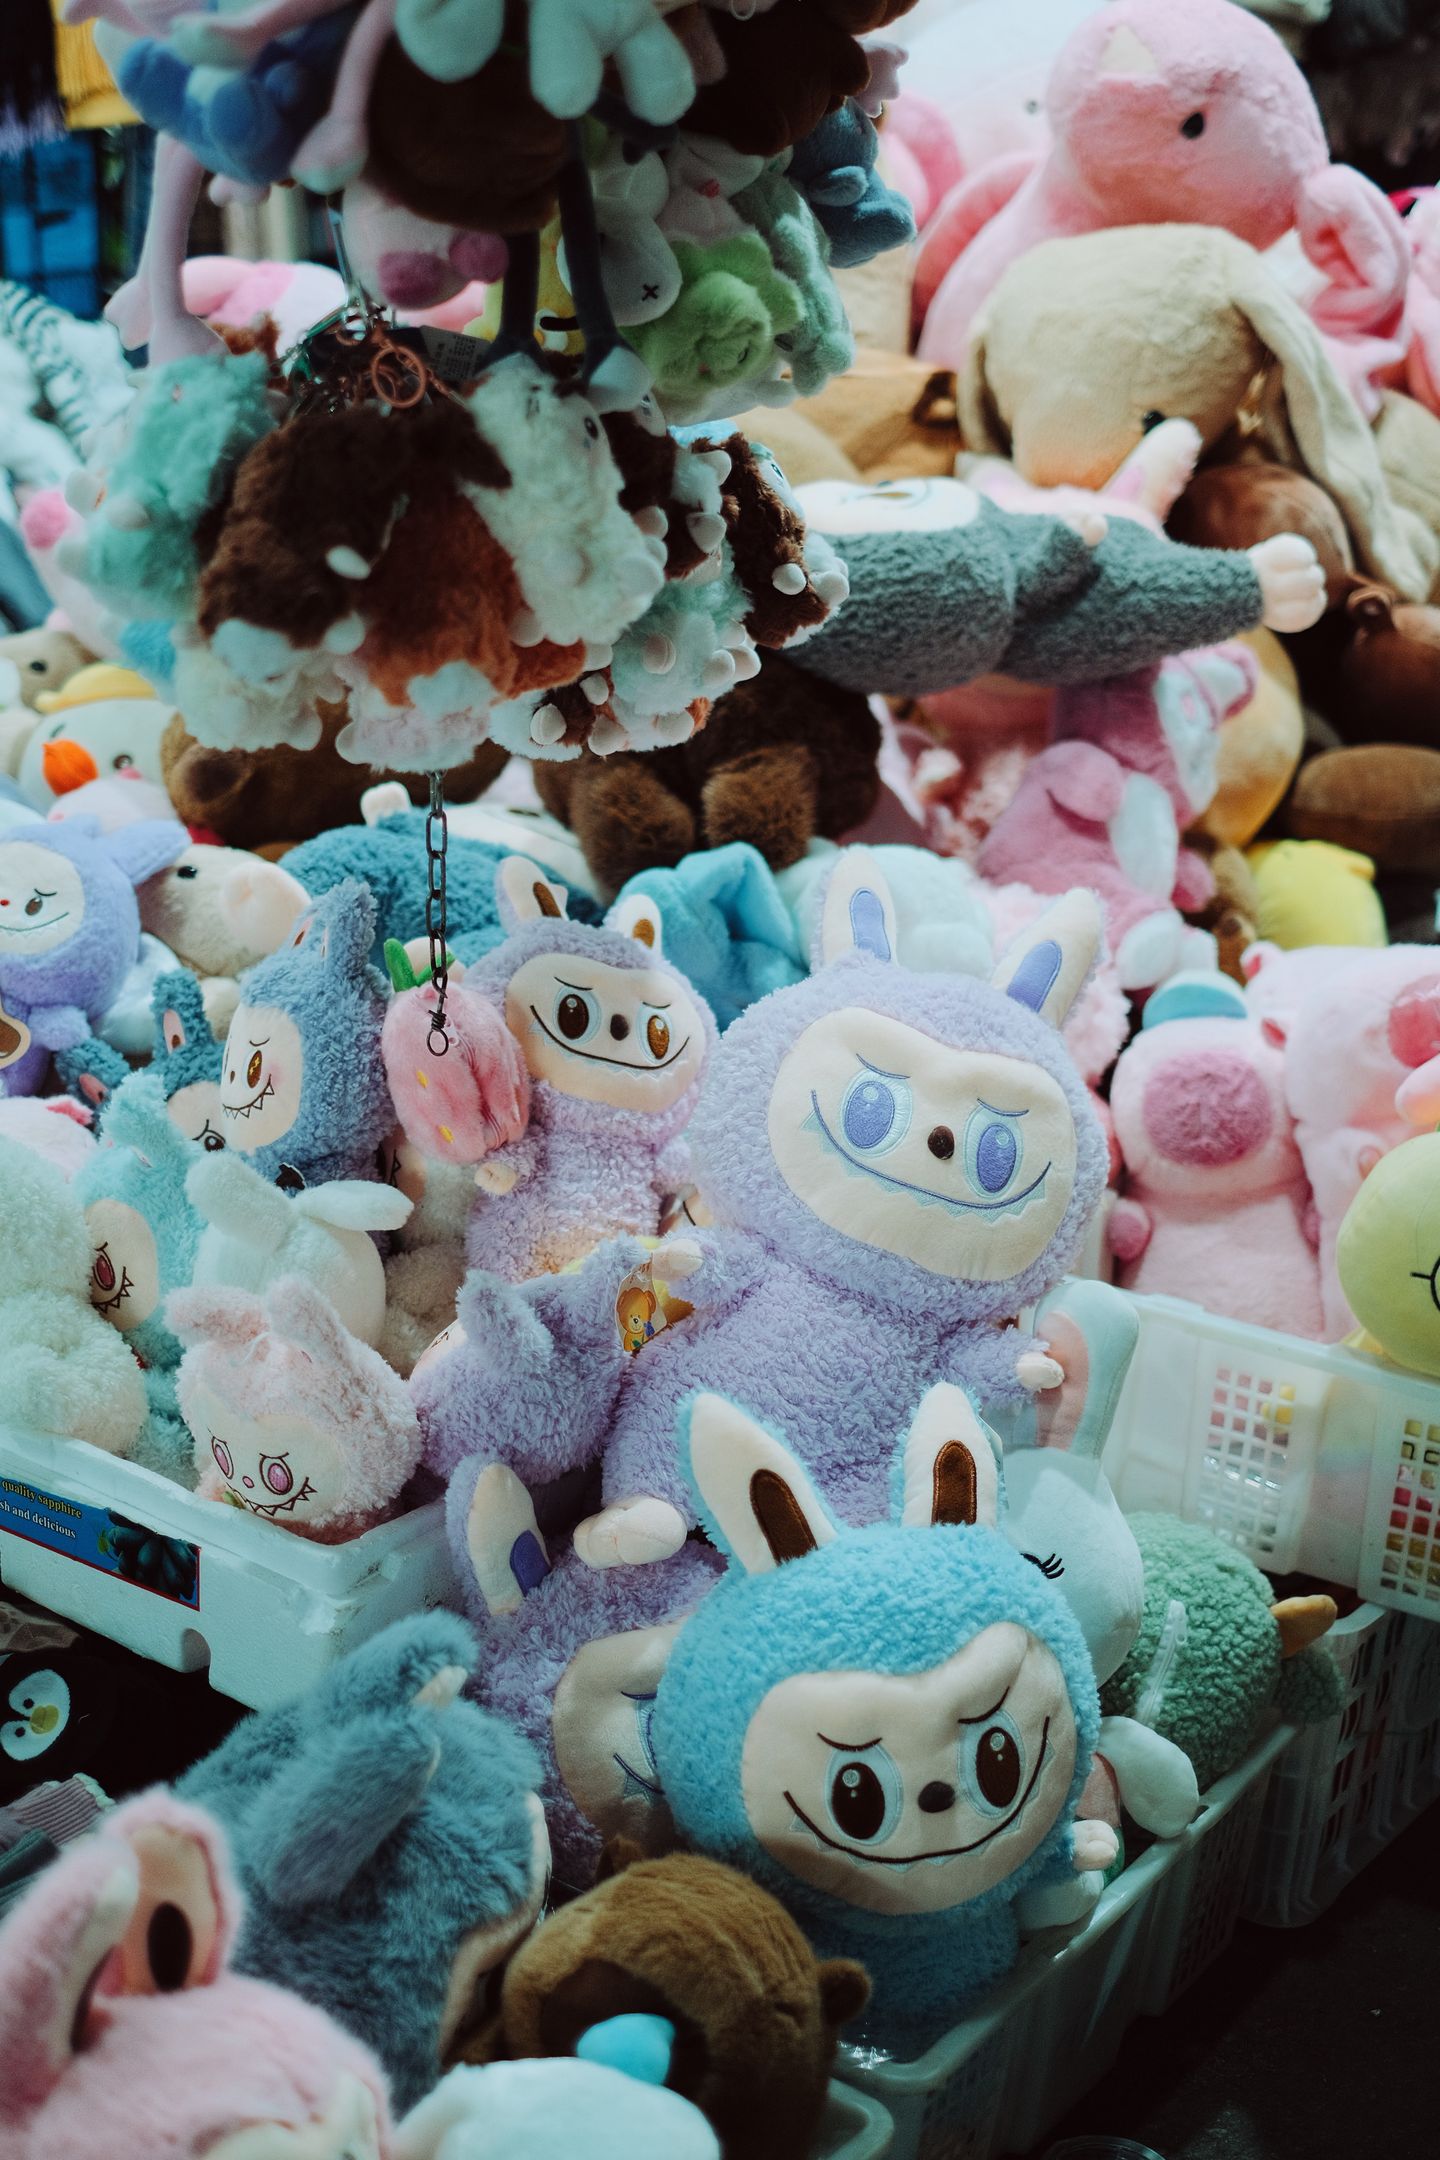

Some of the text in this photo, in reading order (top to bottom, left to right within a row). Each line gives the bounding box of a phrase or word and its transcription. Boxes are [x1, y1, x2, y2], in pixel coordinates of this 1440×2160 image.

[2, 1480, 82, 1518] quality sapphire
[12, 1506, 30, 1520] and
[32, 1513, 76, 1538] delicious
